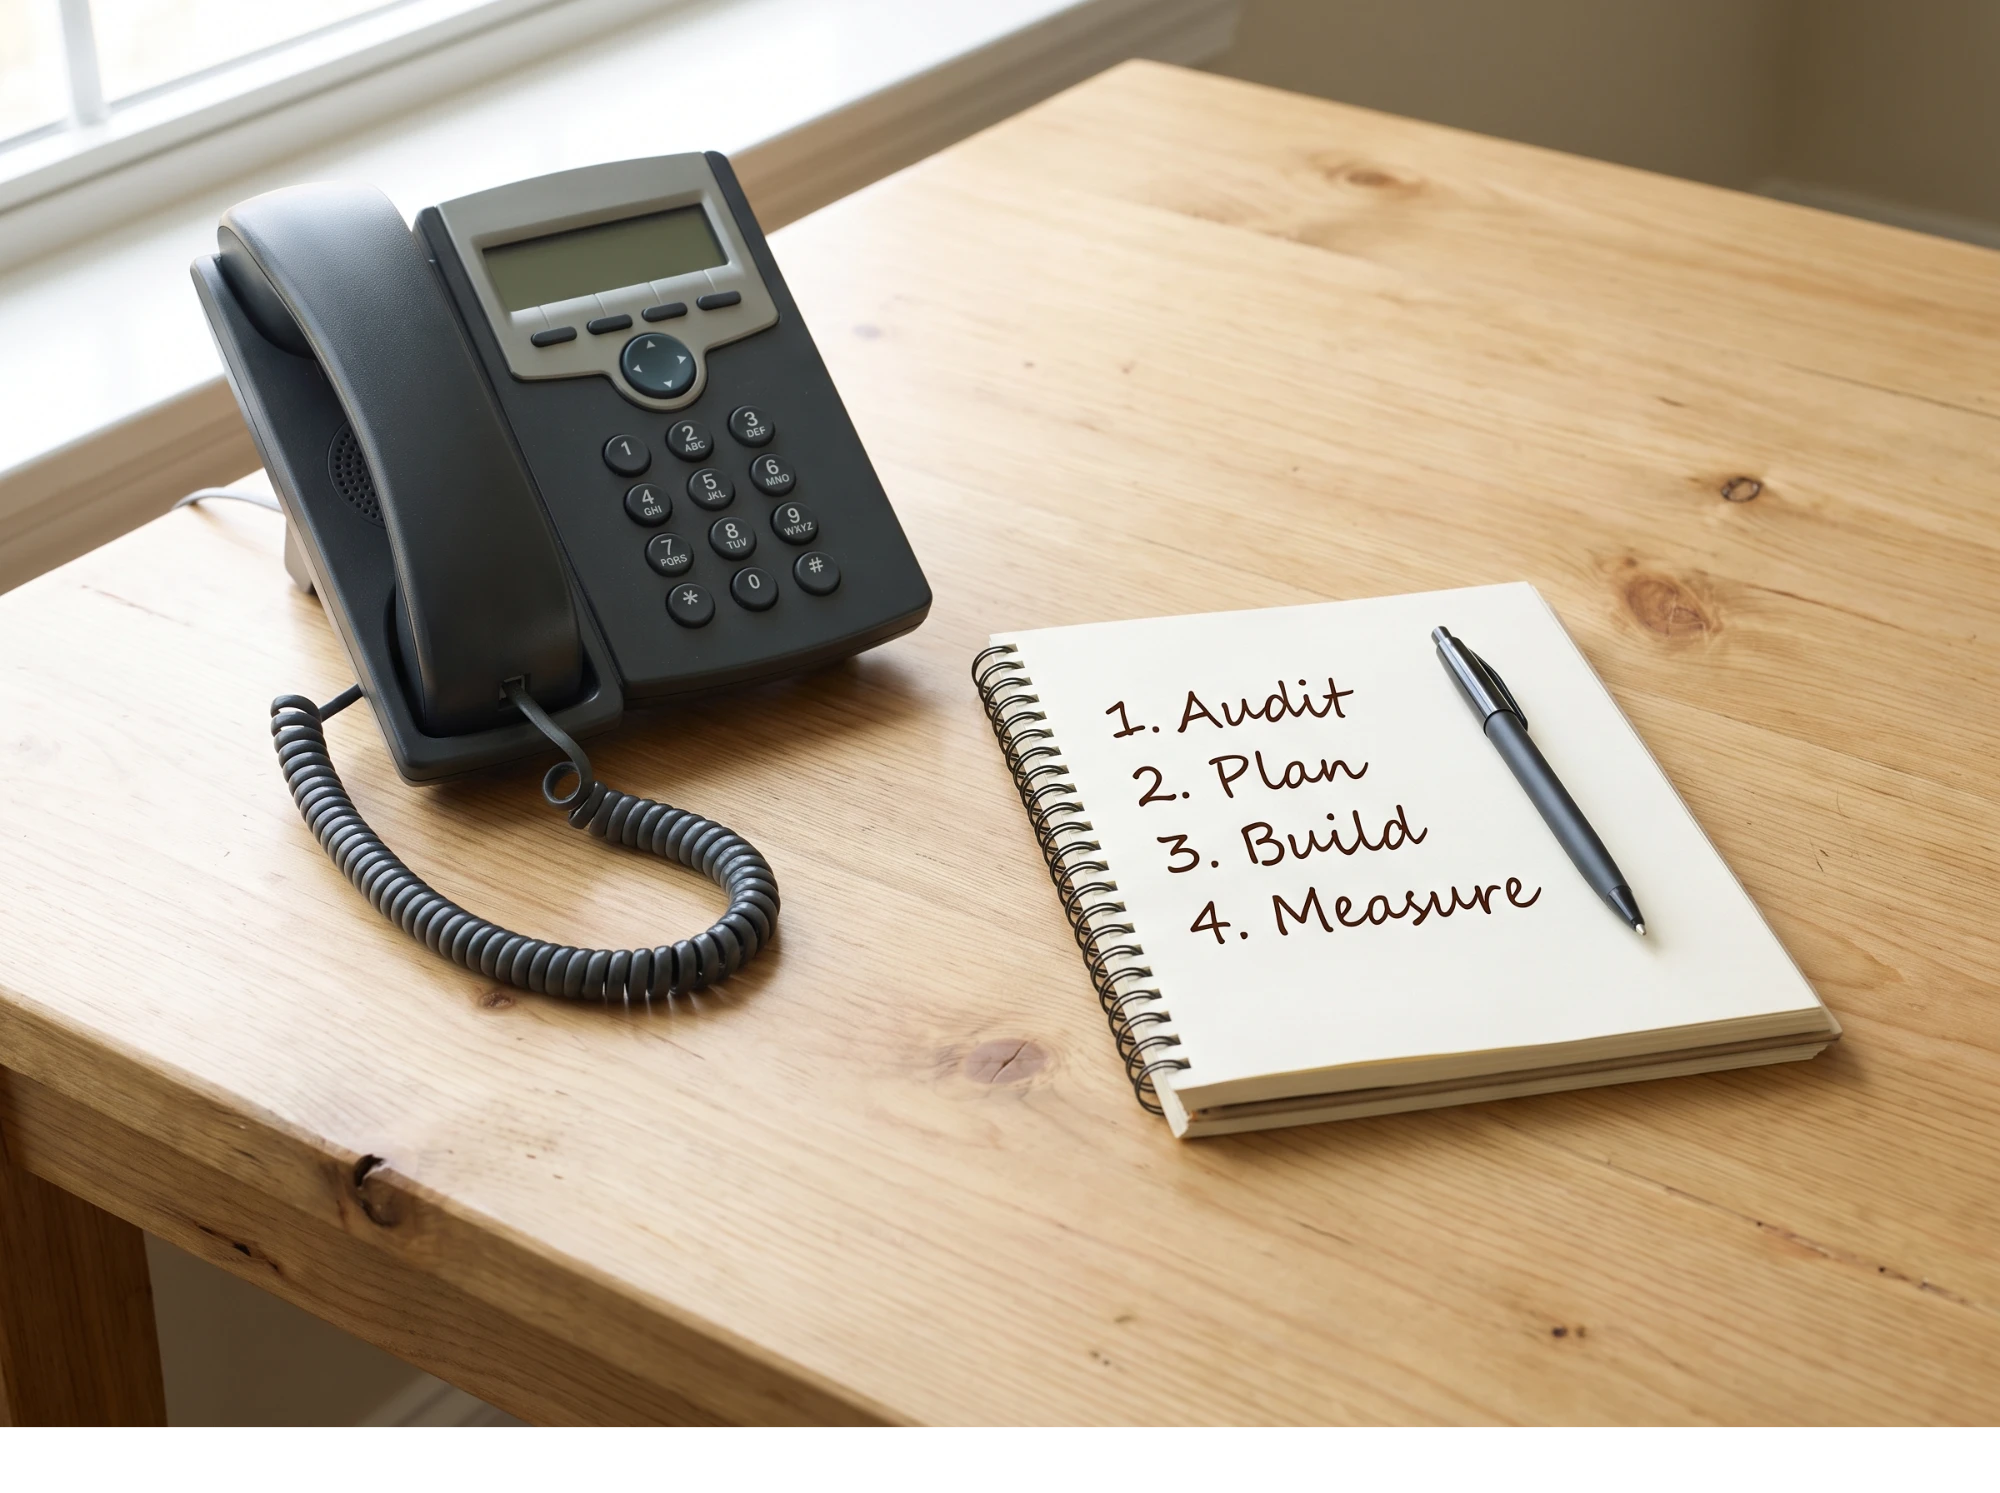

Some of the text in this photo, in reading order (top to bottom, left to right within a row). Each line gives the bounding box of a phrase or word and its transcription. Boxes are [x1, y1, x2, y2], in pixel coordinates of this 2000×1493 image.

[743, 411, 758, 427] 3
[681, 425, 698, 442] 2
[746, 426, 766, 438] DEF
[620, 441, 632, 456] 1
[684, 440, 706, 452] ABC
[765, 459, 780, 475] 6
[702, 473, 717, 490] 5
[765, 473, 790, 486] MNO
[641, 489, 655, 505] 4
[706, 490, 726, 501] JKL
[643, 505, 663, 516] GHI
[787, 507, 801, 524] 9
[725, 523, 739, 539] 8
[784, 521, 813, 536] WXYZ
[660, 538, 672, 556] 7
[726, 538, 747, 549] TUV
[747, 574, 761, 589] 0
[1105, 677, 1354, 739] 1. Audit
[1132, 750, 1369, 808] 2. Plan
[1156, 804, 1428, 874] 3. Build
[1189, 876, 1542, 945] 4. Measure
